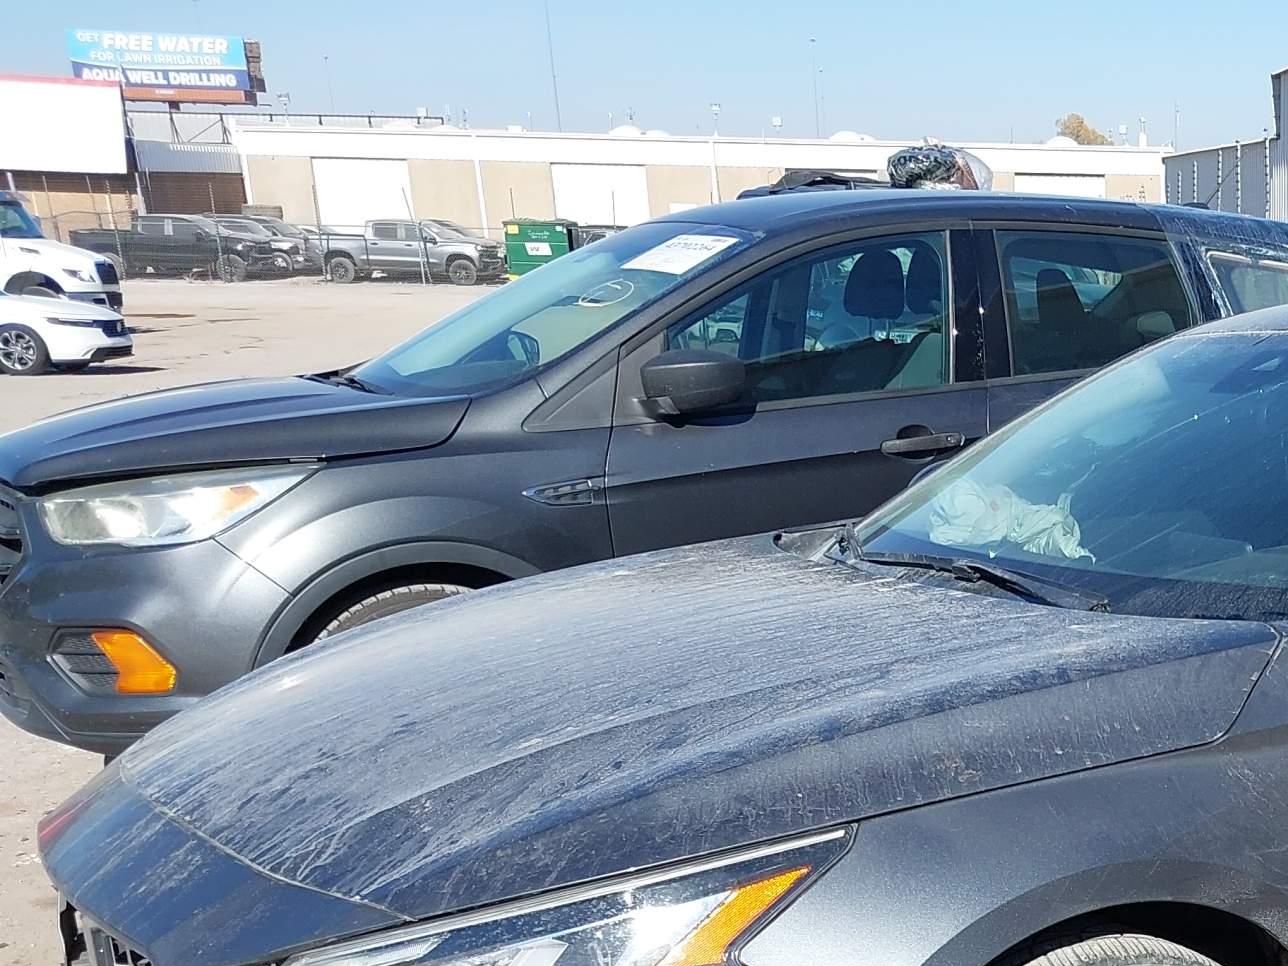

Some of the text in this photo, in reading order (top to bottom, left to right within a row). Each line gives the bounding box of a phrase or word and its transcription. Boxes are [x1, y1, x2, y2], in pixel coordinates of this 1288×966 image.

[77, 32, 228, 54] GET FREE WATER
[91, 49, 114, 61] FOR
[154, 54, 221, 66] IRRIGATION
[82, 67, 237, 87] AQUA WELL DRILLING
